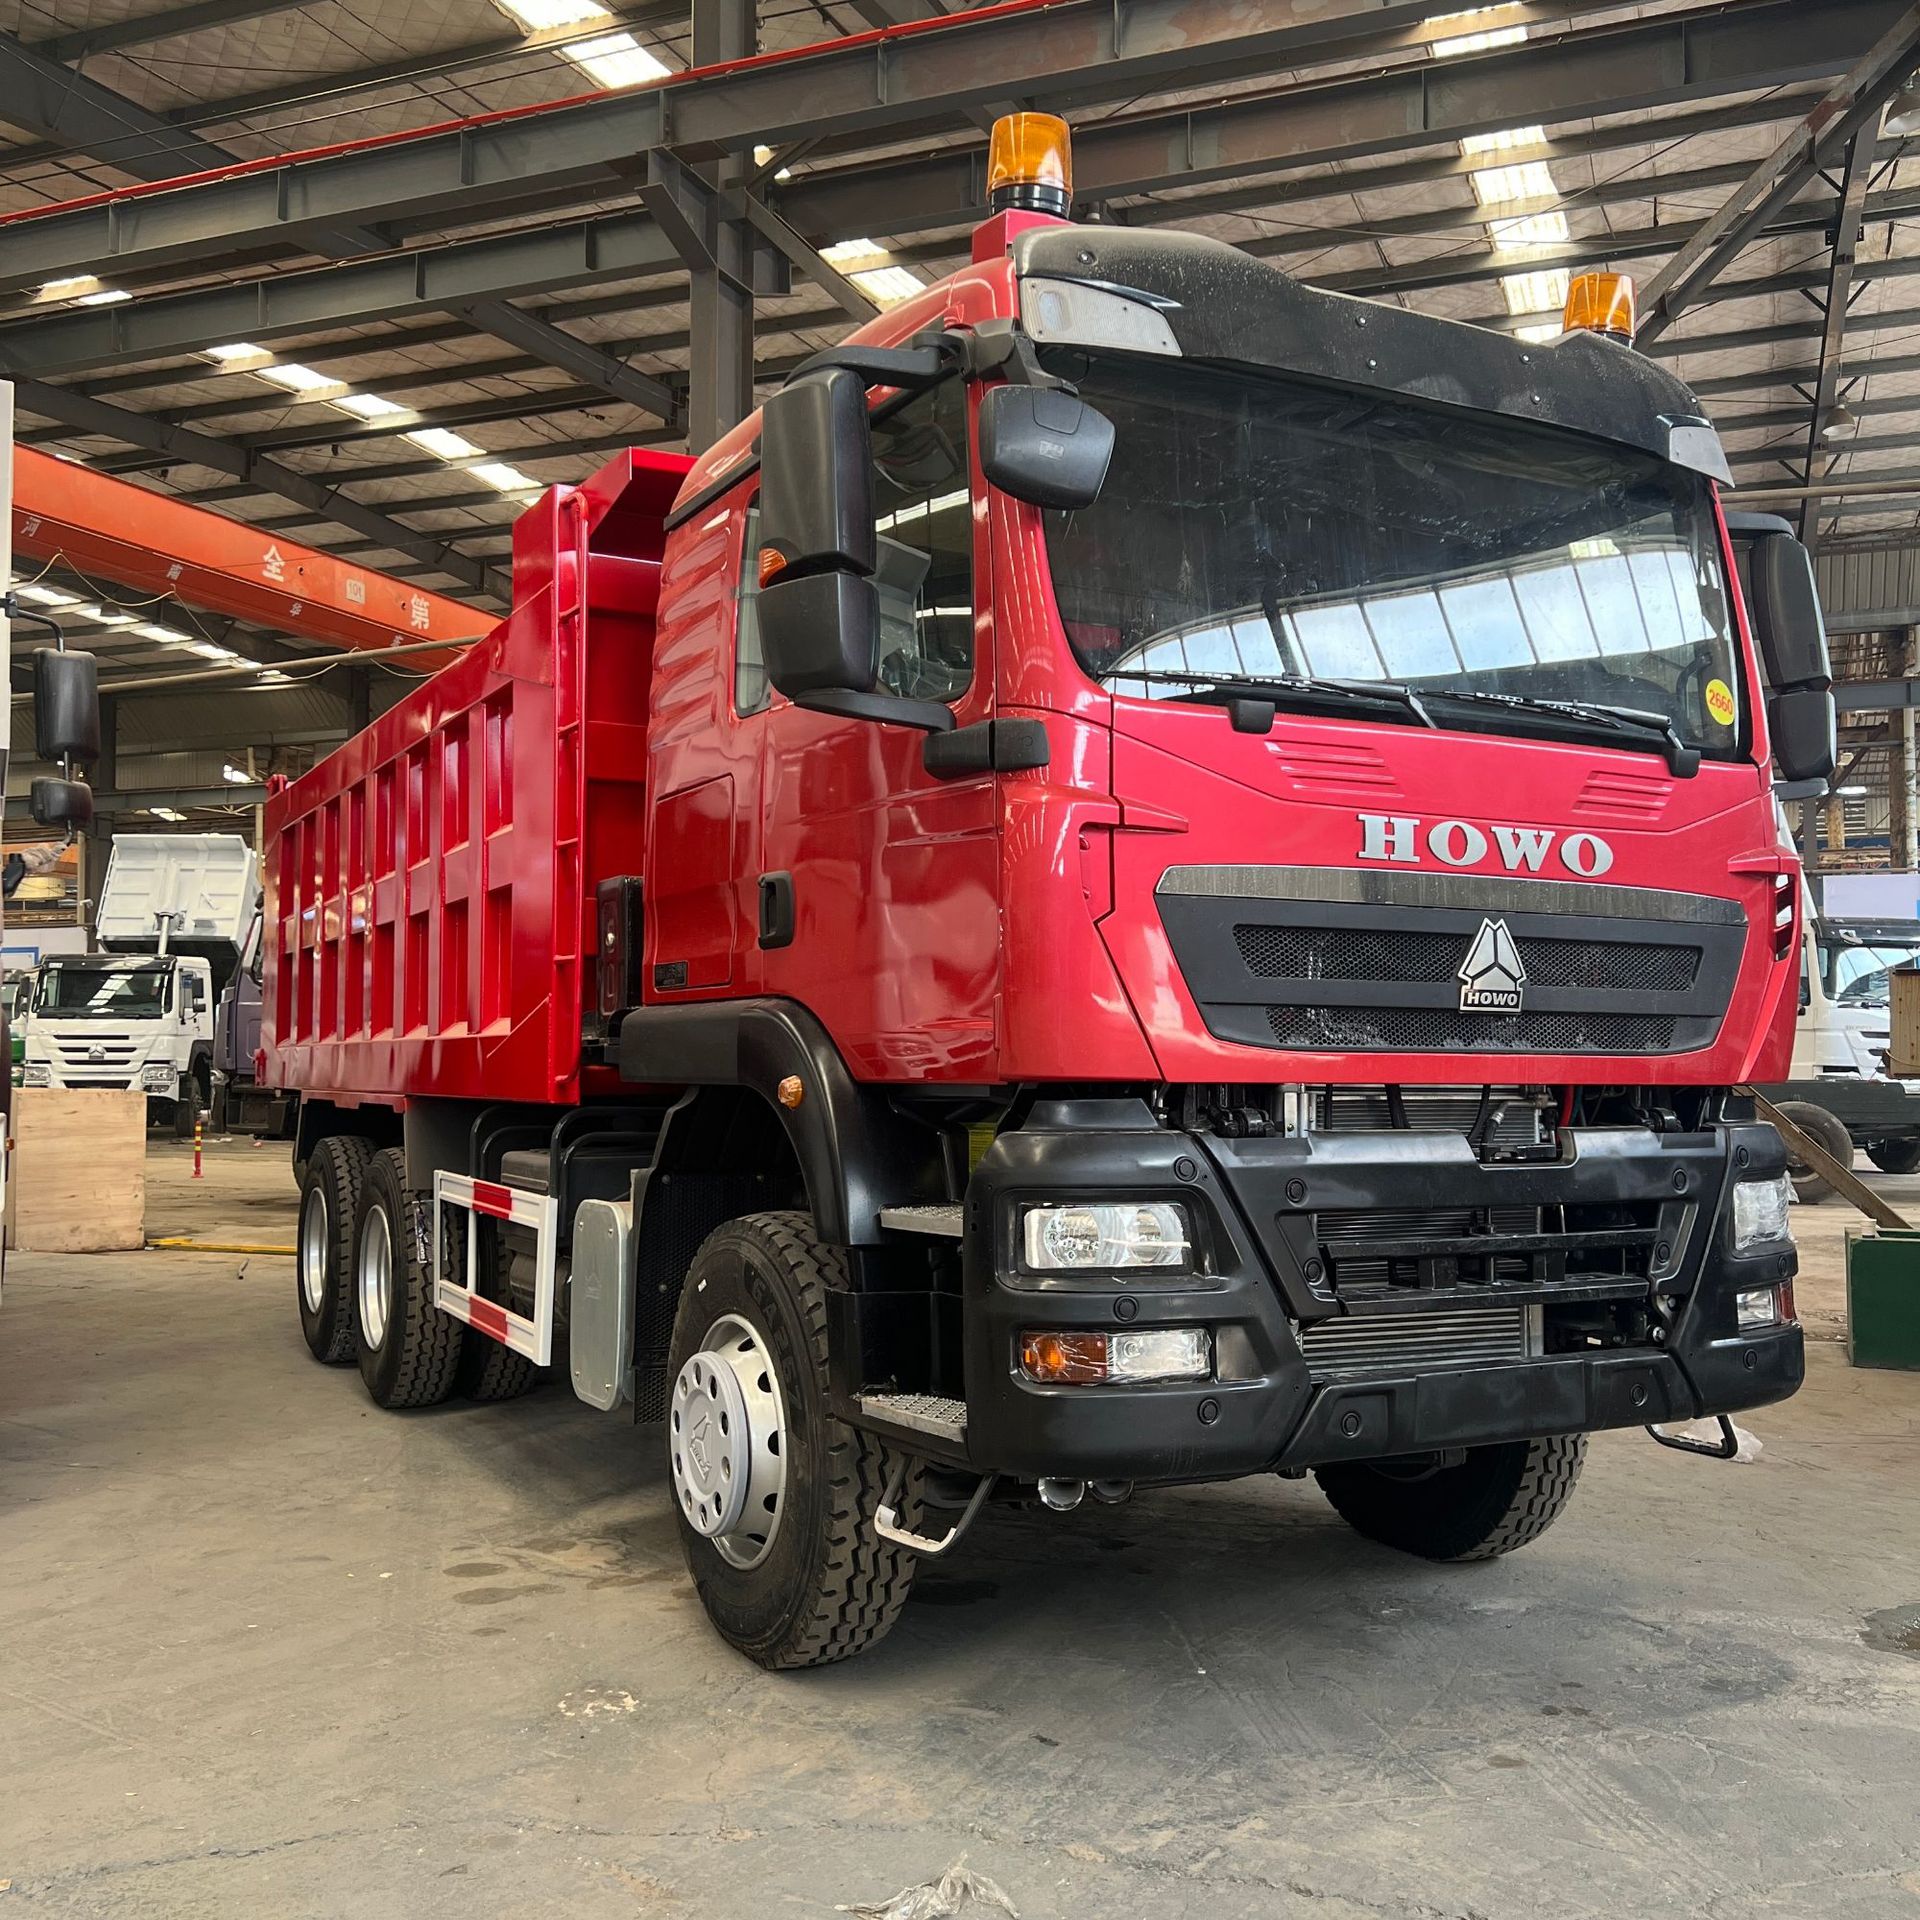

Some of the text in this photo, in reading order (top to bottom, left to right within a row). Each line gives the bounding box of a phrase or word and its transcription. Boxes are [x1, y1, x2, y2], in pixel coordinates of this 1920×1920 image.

[261, 544, 286, 583] 全
[1709, 688, 1734, 716] 2660
[1357, 814, 1614, 877] HOWO
[1467, 990, 1519, 1006] HOWO
